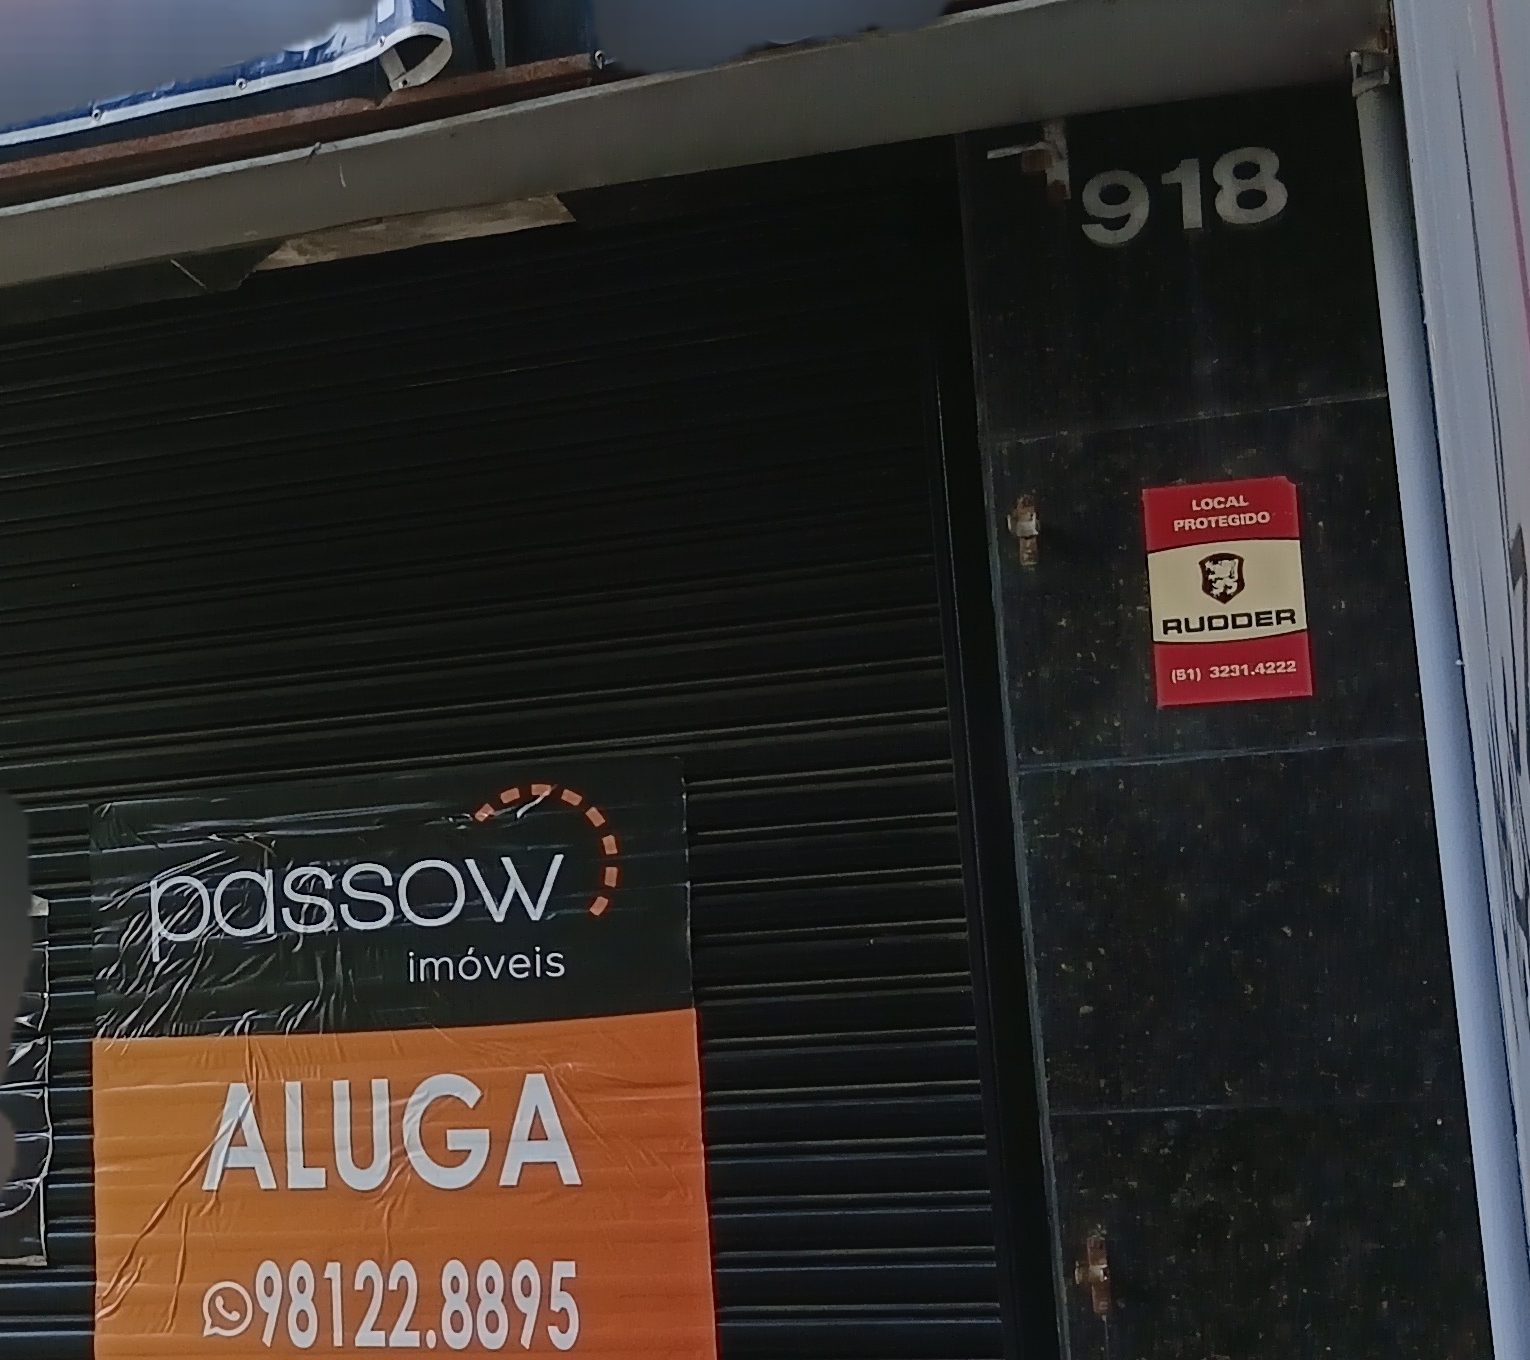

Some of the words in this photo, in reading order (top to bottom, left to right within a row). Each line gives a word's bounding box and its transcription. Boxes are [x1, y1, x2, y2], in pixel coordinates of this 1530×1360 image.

[1081, 146, 1288, 245] 918
[1173, 511, 1271, 531] PROTEGIDO
[1191, 494, 1249, 511] LOCAL
[1162, 608, 1297, 635] RUDDER
[1171, 668, 1202, 684] (51)
[148, 854, 564, 961] passow
[407, 945, 566, 984] imóveis
[201, 1072, 583, 1192] ALUGA
[254, 1258, 581, 1350] 98122.8895
